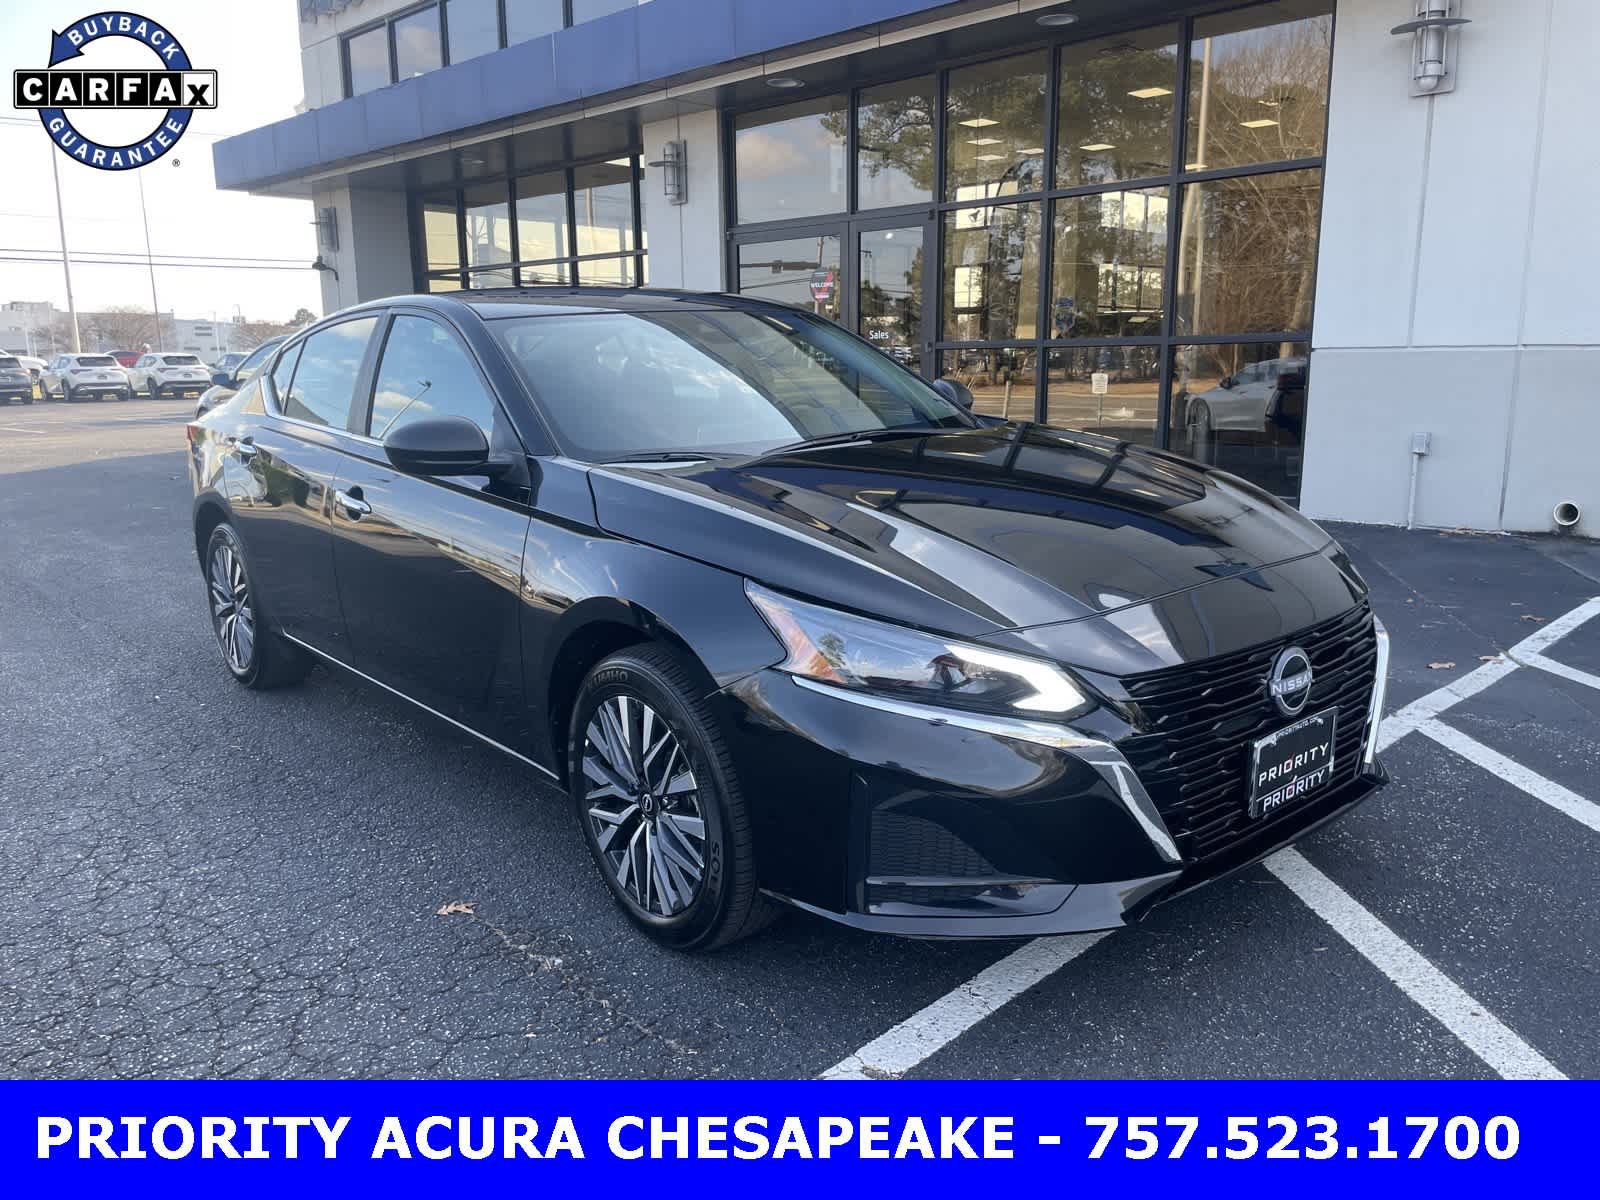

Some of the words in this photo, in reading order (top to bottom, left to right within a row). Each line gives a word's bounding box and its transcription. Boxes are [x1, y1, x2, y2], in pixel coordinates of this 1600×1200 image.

[869, 330, 889, 340] Sales
[1258, 742, 1329, 787] PRIORITY
[1263, 769, 1325, 812] PRIORITY
